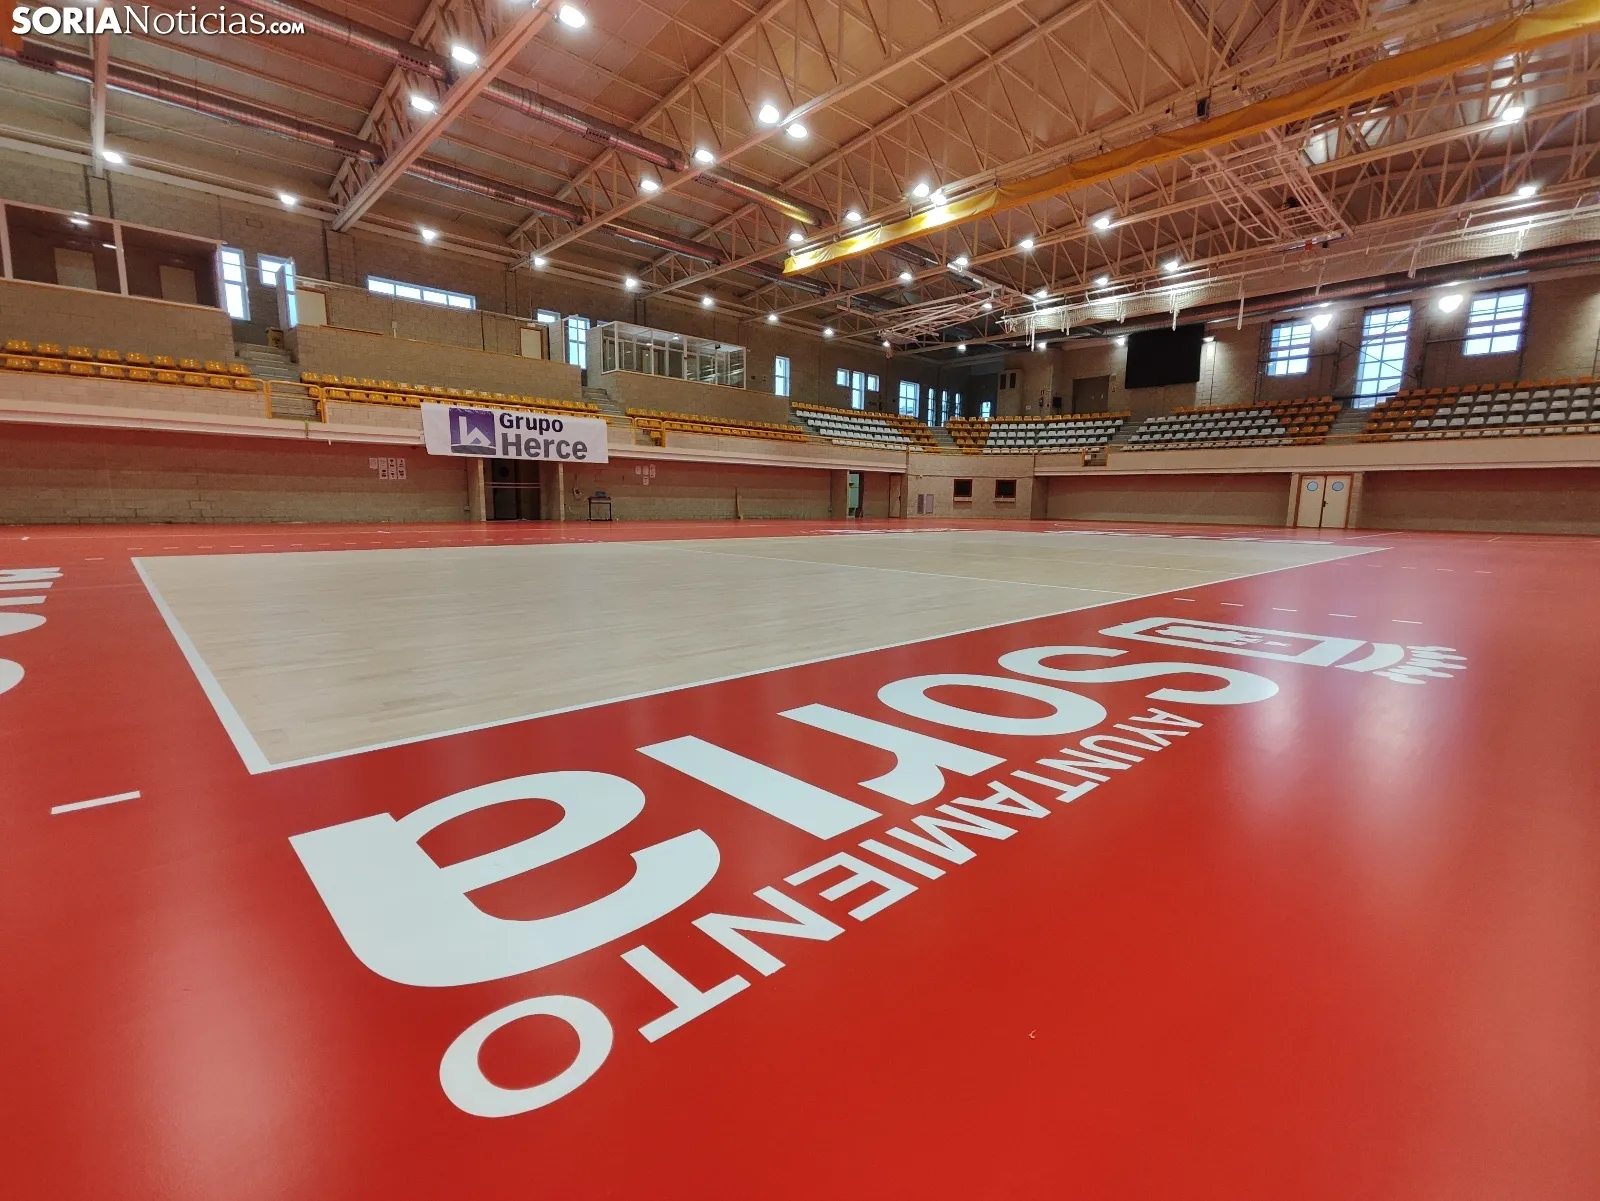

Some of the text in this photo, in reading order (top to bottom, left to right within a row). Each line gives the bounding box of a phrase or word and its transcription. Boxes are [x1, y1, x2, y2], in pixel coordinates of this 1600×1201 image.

[499, 412, 564, 435] Grupo
[502, 433, 588, 460] Herce
[440, 707, 1204, 1118] AYUNTAMIENTO
